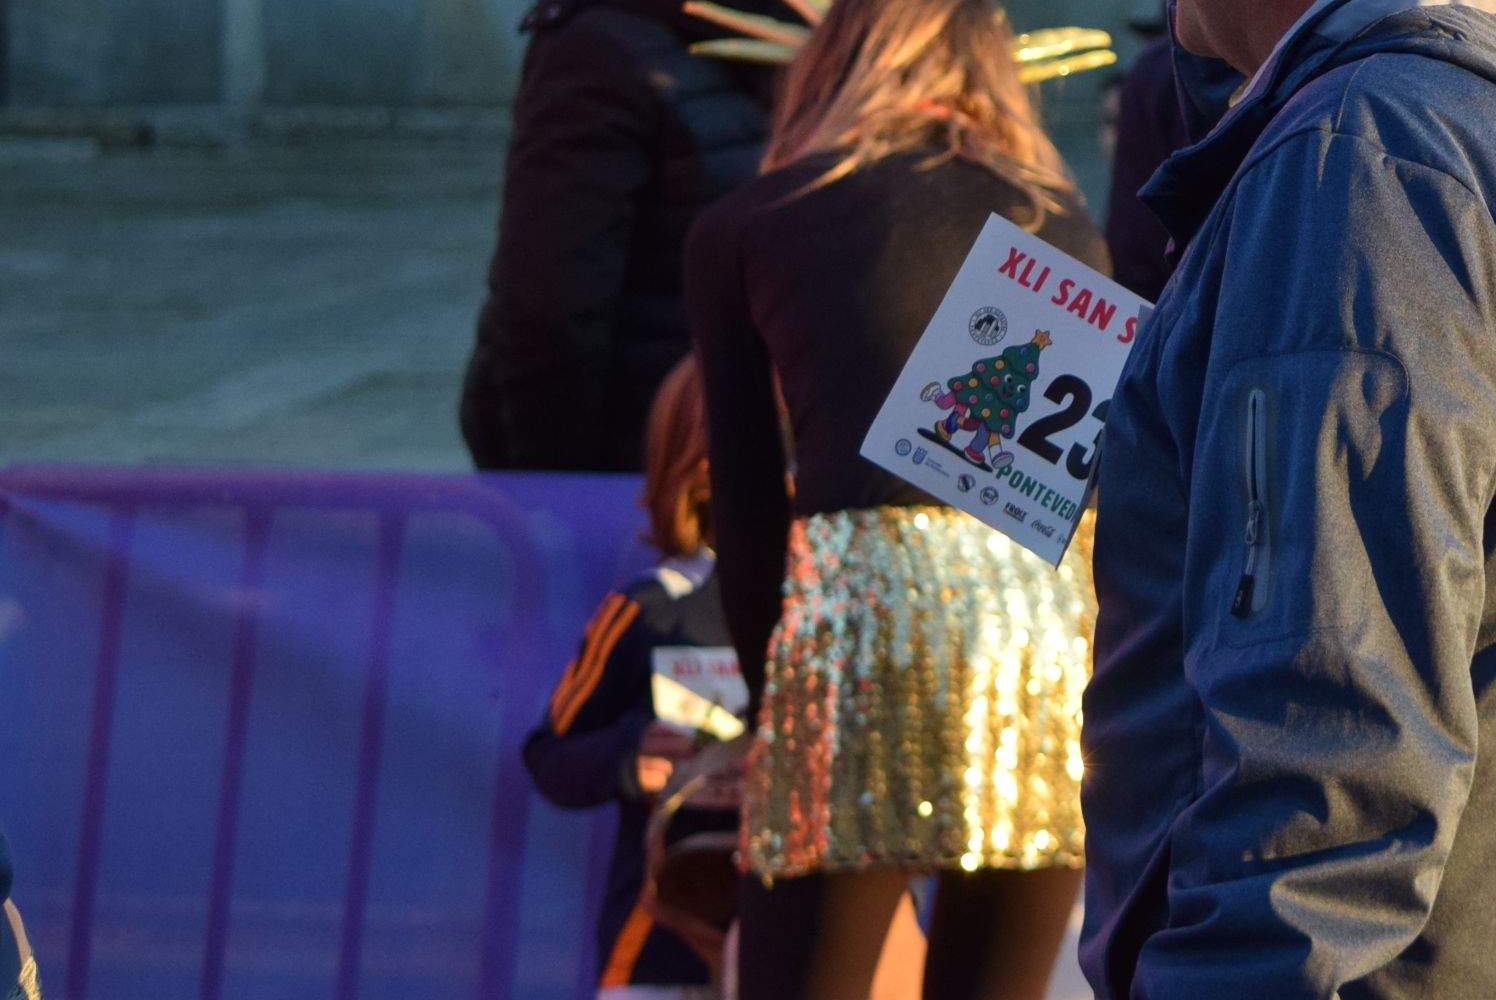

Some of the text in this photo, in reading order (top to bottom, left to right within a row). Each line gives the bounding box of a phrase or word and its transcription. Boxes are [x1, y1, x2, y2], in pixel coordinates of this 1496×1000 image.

[998, 247, 1051, 293] XLI
[1051, 278, 1117, 331] SAN
[996, 464, 1078, 522] PONTEVED
